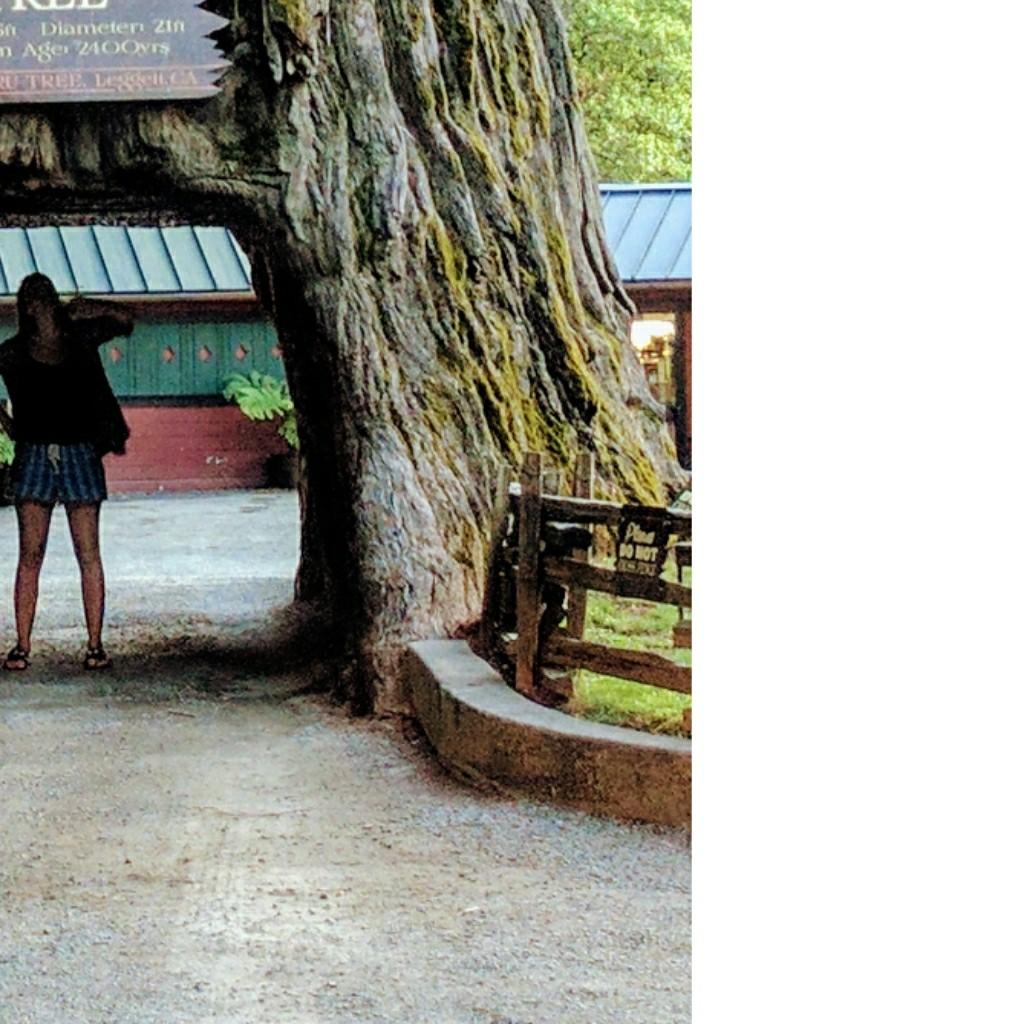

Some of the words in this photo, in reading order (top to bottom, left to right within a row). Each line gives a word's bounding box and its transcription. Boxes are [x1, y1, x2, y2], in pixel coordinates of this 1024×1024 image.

[40, 20, 145, 37] Diameter:
[154, 18, 186, 34] 21ft
[22, 41, 70, 64] Age:
[78, 39, 171, 58] 2400yrs
[635, 545, 658, 562] NOT
